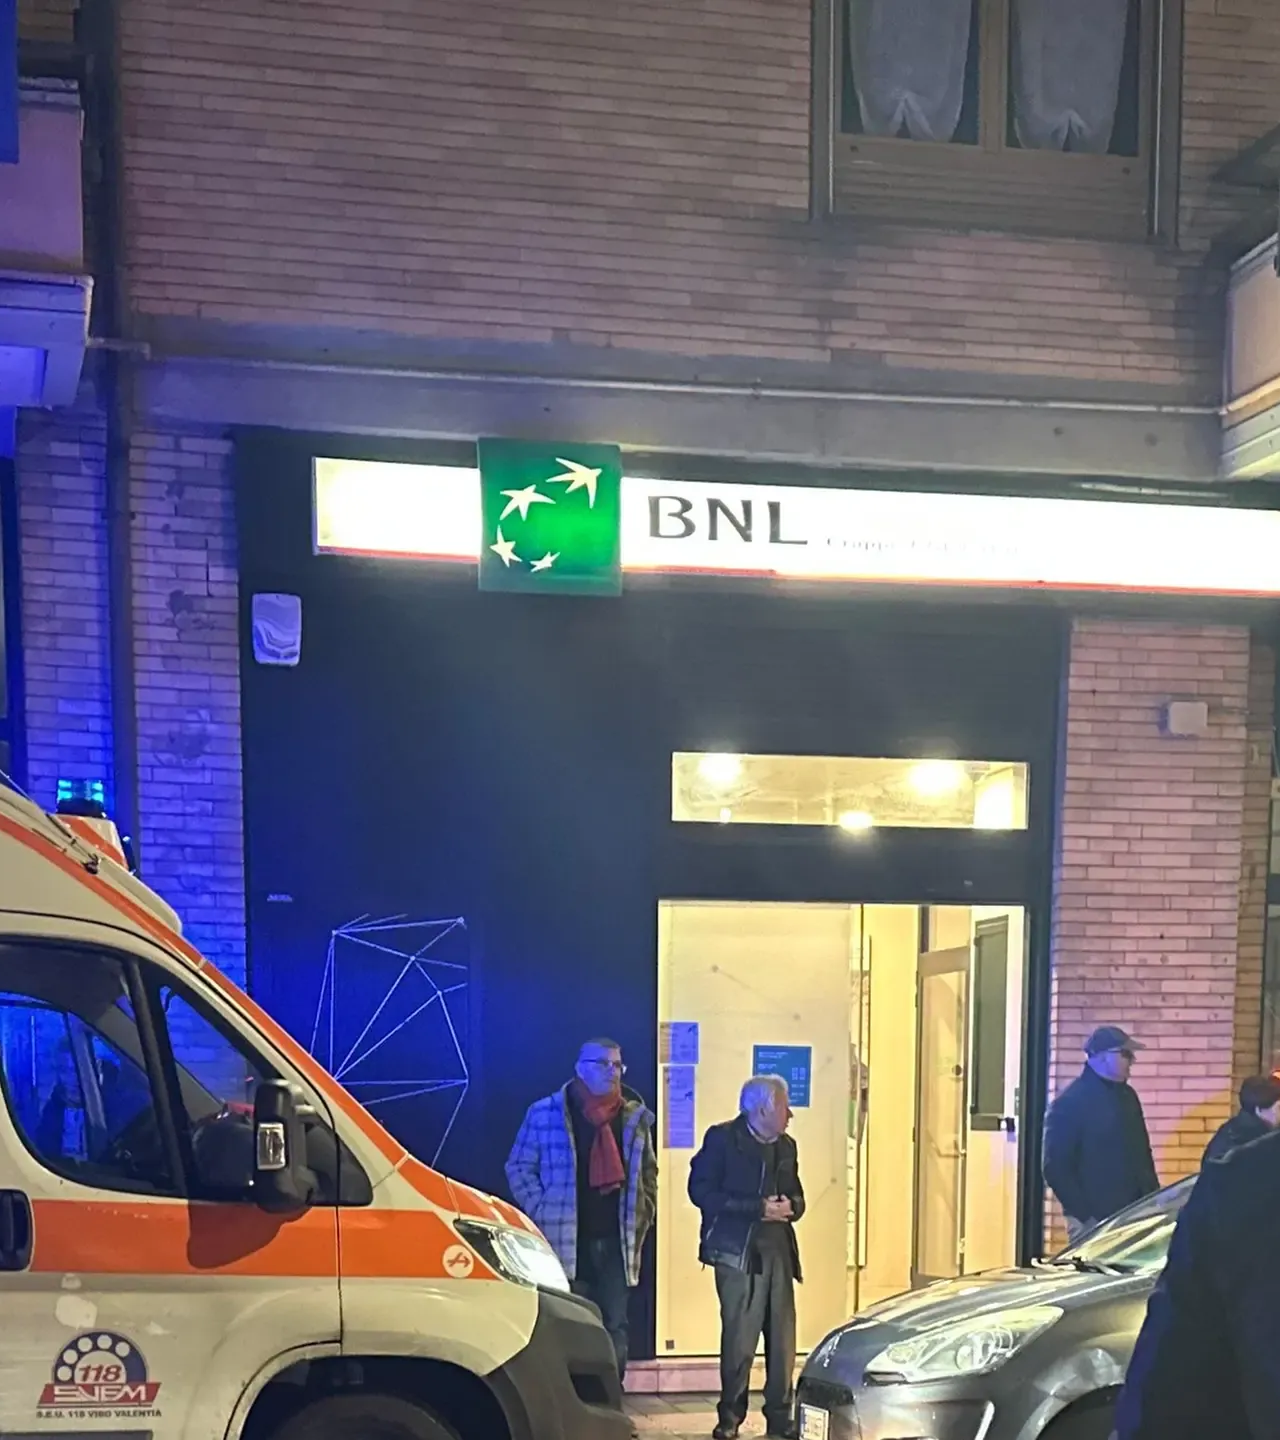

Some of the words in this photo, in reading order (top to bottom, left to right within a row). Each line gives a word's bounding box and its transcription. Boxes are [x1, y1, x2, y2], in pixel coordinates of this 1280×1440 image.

[647, 495, 808, 546] BNL
[78, 1364, 123, 1383] 118
[115, 1409, 162, 1418] VALENTIA
